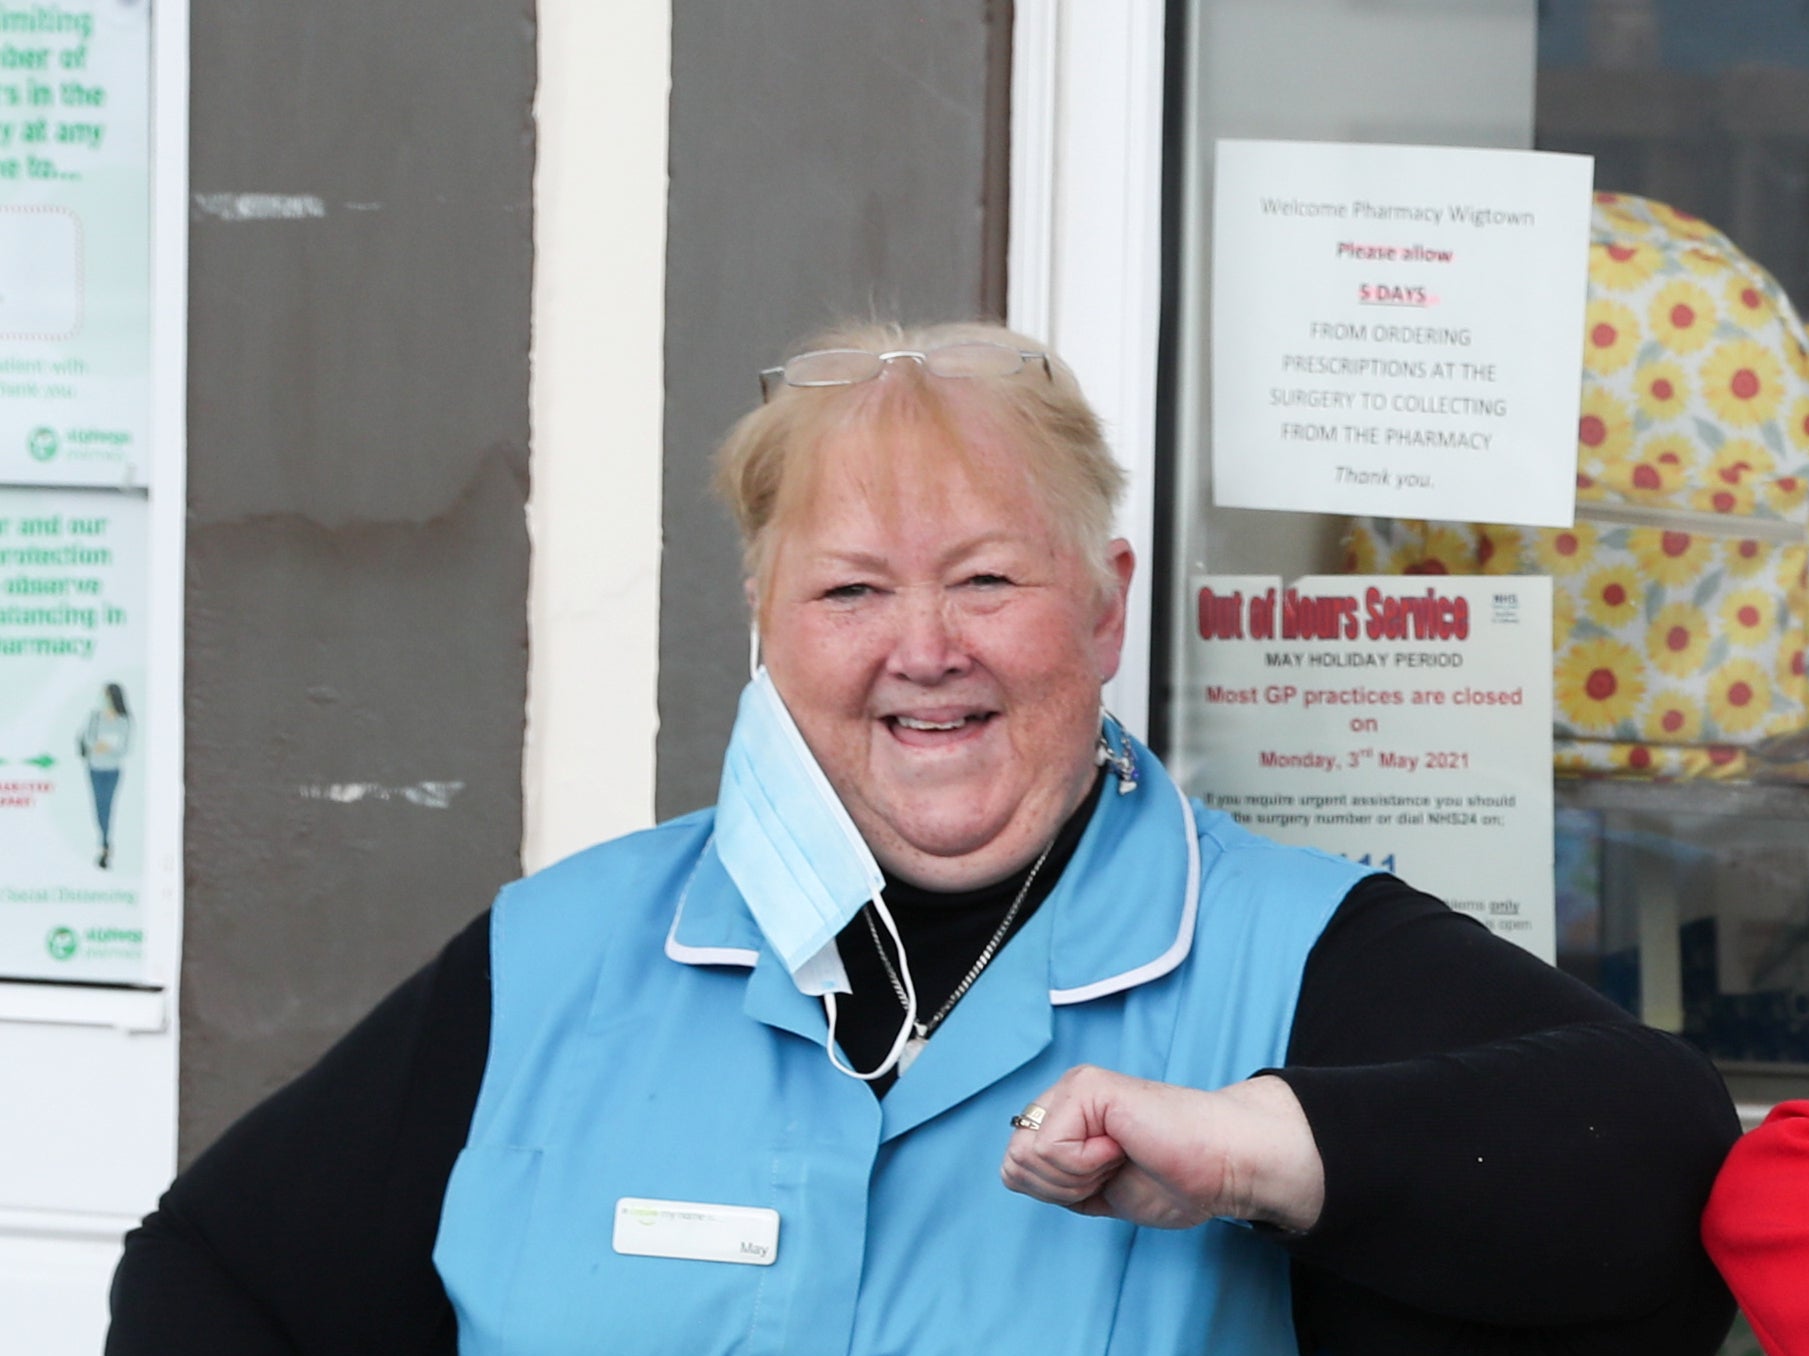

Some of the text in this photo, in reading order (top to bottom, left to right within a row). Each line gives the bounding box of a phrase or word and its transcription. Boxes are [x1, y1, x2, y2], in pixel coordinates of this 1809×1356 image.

[60, 44, 87, 69] of
[27, 79, 52, 106] in
[60, 81, 106, 107] the
[23, 118, 47, 143] at
[57, 122, 104, 150] any
[1260, 198, 1534, 227] Welcome Pharmacy Wigtown
[1336, 242, 1454, 263] Please allow
[1359, 284, 1428, 304] 5 DAYS
[1310, 322, 1472, 347] FROM ORDERING
[1282, 355, 1497, 382] PRESCRIPTIONS AT THE
[1269, 389, 1507, 417] SURGERY TO COLLECTING
[1281, 423, 1493, 450] FROM THE PHARMACY
[1335, 466, 1435, 489] Thank you.
[21, 514, 60, 535] and
[103, 602, 126, 625] in
[1198, 586, 1471, 642] Out of Hours Service
[1265, 653, 1463, 668] MAY HOLIDAY PERIOD
[1206, 686, 1523, 708] Most GP practices are closed
[1350, 719, 1378, 733] on
[1259, 752, 1342, 771] Monday,
[1379, 752, 1419, 771] May
[1425, 753, 1470, 769] 2021
[1216, 796, 1242, 808] you
[1244, 793, 1295, 808] require
[1300, 795, 1347, 809] urgent
[1352, 794, 1430, 808] assistance
[1435, 797, 1464, 810] you
[1467, 794, 1516, 808] should
[1257, 813, 1311, 827] surgery
[1316, 812, 1373, 825] number
[1377, 815, 1393, 825] or
[1396, 813, 1424, 826] dial
[1428, 812, 1477, 826] NHS24
[1489, 899, 1520, 914] only
[740, 1242, 770, 1257] May
